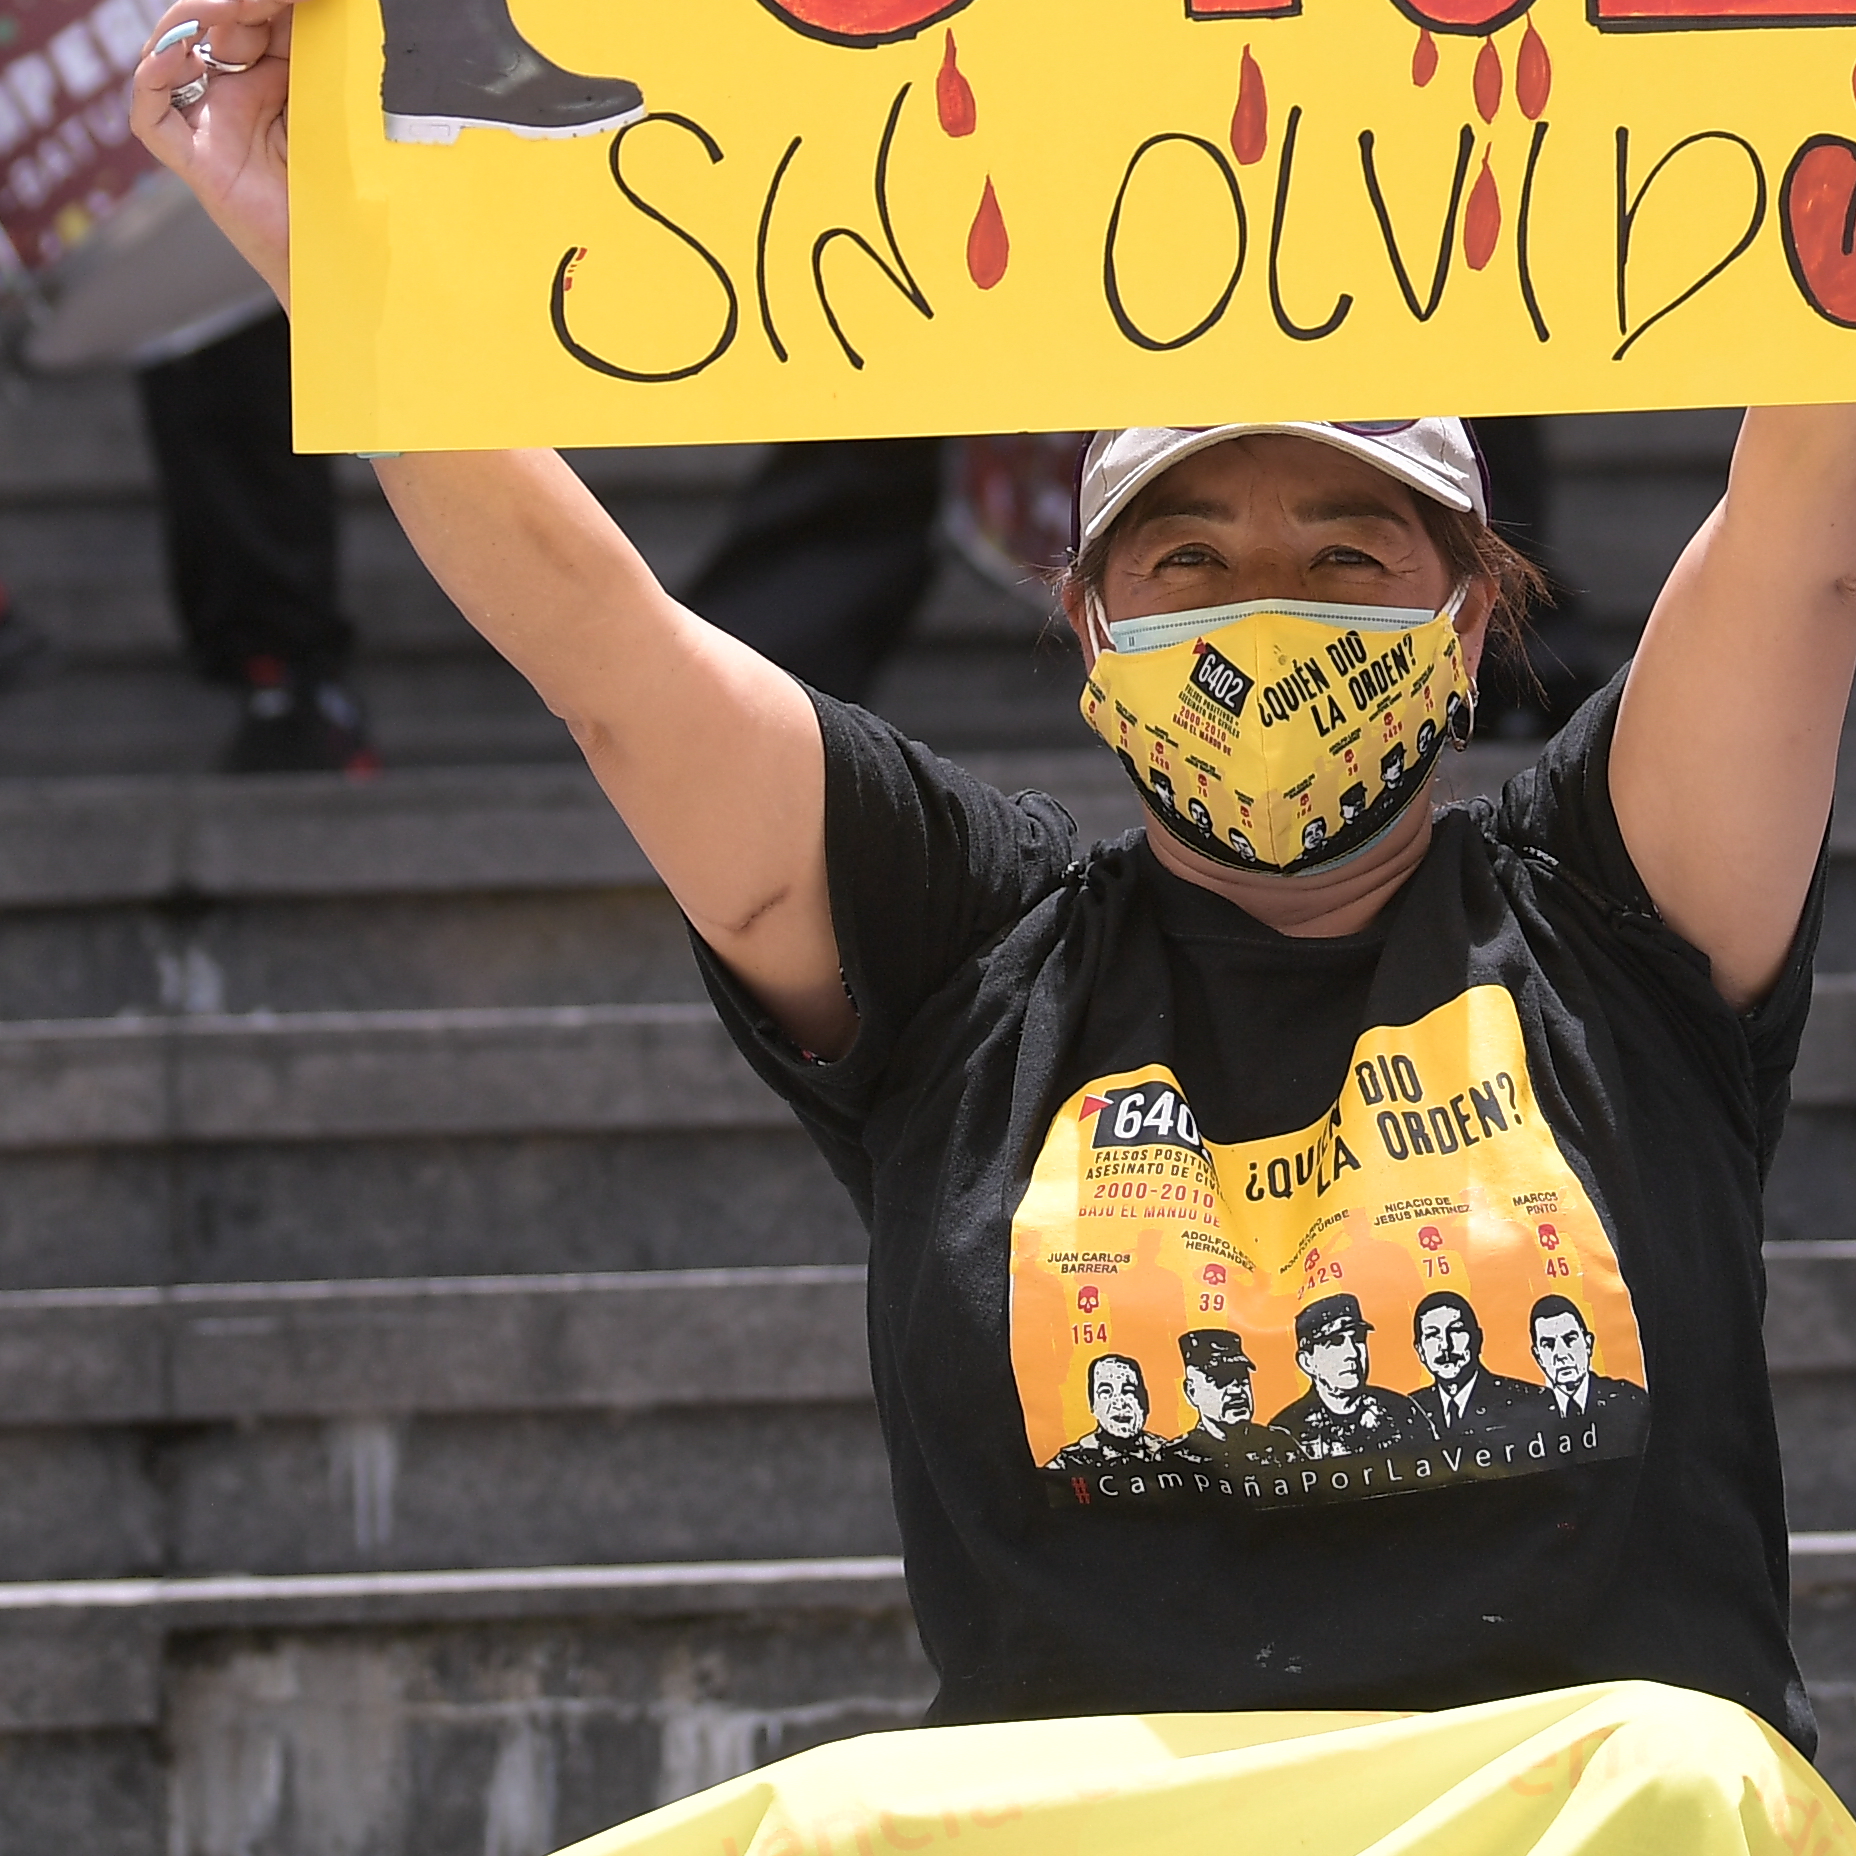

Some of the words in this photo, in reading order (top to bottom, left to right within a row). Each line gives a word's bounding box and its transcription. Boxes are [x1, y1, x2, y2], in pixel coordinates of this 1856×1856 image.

[552, 83, 936, 382] SIN
[1198, 653, 1244, 708] 6402
[1257, 657, 1331, 728] ¿QUIÉN
[1325, 630, 1367, 677] DIO
[1310, 694, 1347, 738] LA
[1348, 633, 1416, 711] ORDEN?
[1179, 705, 1226, 742] 2000-2010
[1354, 1054, 1424, 1106] DIO
[1113, 1090, 1206, 1154] 640
[1317, 1135, 1362, 1198] LA
[1376, 1071, 1523, 1162] ORDEN?
[1086, 1162, 1164, 1180] ASESINATO
[1170, 1164, 1189, 1178] DE
[1095, 1149, 1149, 1164] FALSOS
[1154, 1148, 1213, 1178] POSITIV
[1094, 1182, 1213, 1208] 2000-2010
[1384, 1197, 1433, 1213] NICACIO
[1435, 1196, 1452, 1206] DE
[1512, 1191, 1559, 1207] MARCOS
[1121, 1204, 1138, 1218] EL
[1204, 1212, 1221, 1228] DE
[1317, 1209, 1350, 1232] URIBE
[1373, 1210, 1412, 1226] JESUS
[1526, 1203, 1558, 1215] PINTO
[1180, 1230, 1231, 1250] ADOLFO
[1047, 1252, 1078, 1263] JUAN
[1082, 1252, 1131, 1263] CARLOS
[1186, 1240, 1255, 1273] HERNANDEZ
[1422, 1255, 1450, 1278] 75
[1546, 1256, 1570, 1279] 45
[1061, 1263, 1118, 1274] BARRERA
[1199, 1293, 1225, 1312] 39
[1071, 1322, 1108, 1345] 154
[1072, 1422, 1599, 1505] #CampañaPorLaVerdad
